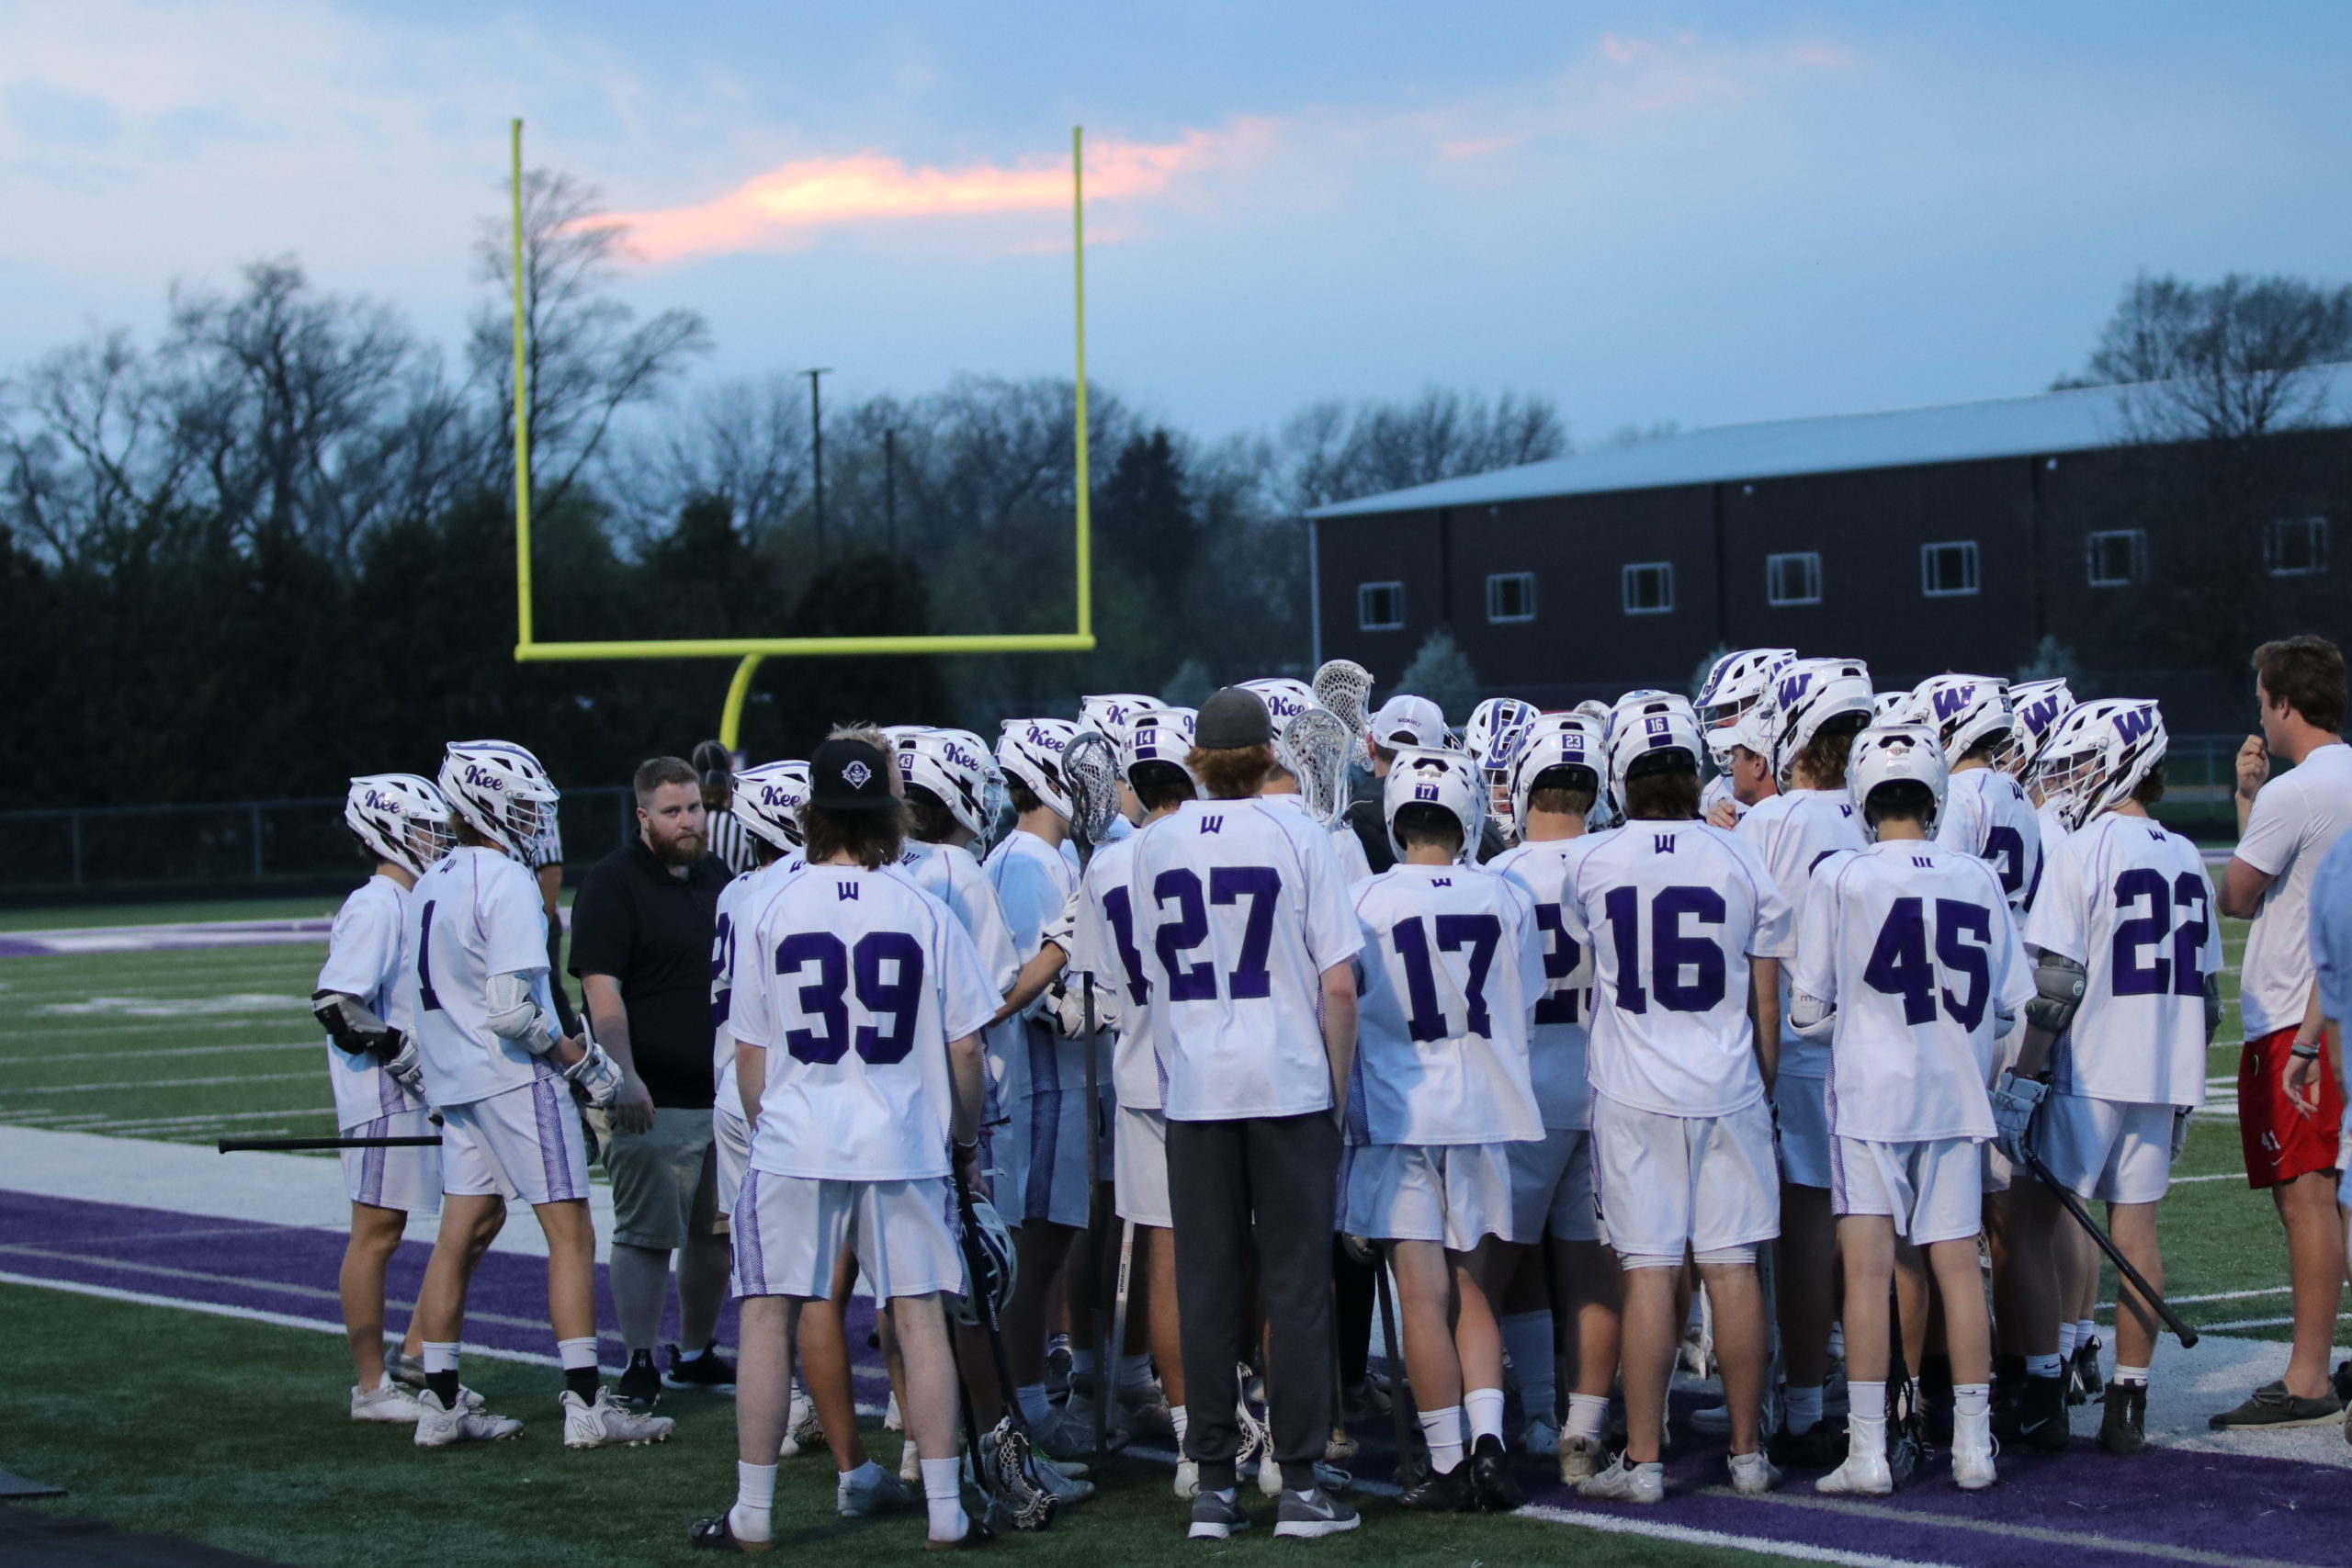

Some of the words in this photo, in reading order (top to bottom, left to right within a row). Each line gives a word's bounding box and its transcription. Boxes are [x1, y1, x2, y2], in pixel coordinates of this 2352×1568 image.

[1776, 673, 1813, 713] W
[1932, 685, 1975, 722] W
[1651, 719, 1664, 731] 16
[2021, 694, 2059, 736] W
[2113, 706, 2153, 746] W
[1026, 726, 1066, 753] Kee
[1138, 731, 1153, 745] 14
[1566, 736, 1581, 748] 23
[899, 755, 912, 768] 43
[944, 742, 979, 771] Kee
[465, 765, 503, 791] Kee
[365, 790, 400, 814] Kee
[761, 785, 800, 807] Kee
[1420, 784, 1433, 799] 17
[1200, 816, 1224, 834] W
[2147, 829, 2166, 842] W
[1654, 834, 1675, 854] W
[837, 882, 859, 901] W
[1154, 866, 1282, 1001] 27
[2112, 868, 2209, 997] 22
[1605, 886, 1726, 1014] 16
[1392, 914, 1502, 1041] 17
[1863, 897, 1992, 1033] 45
[775, 931, 924, 1065] 39
[2261, 1130, 2281, 1151] 41
